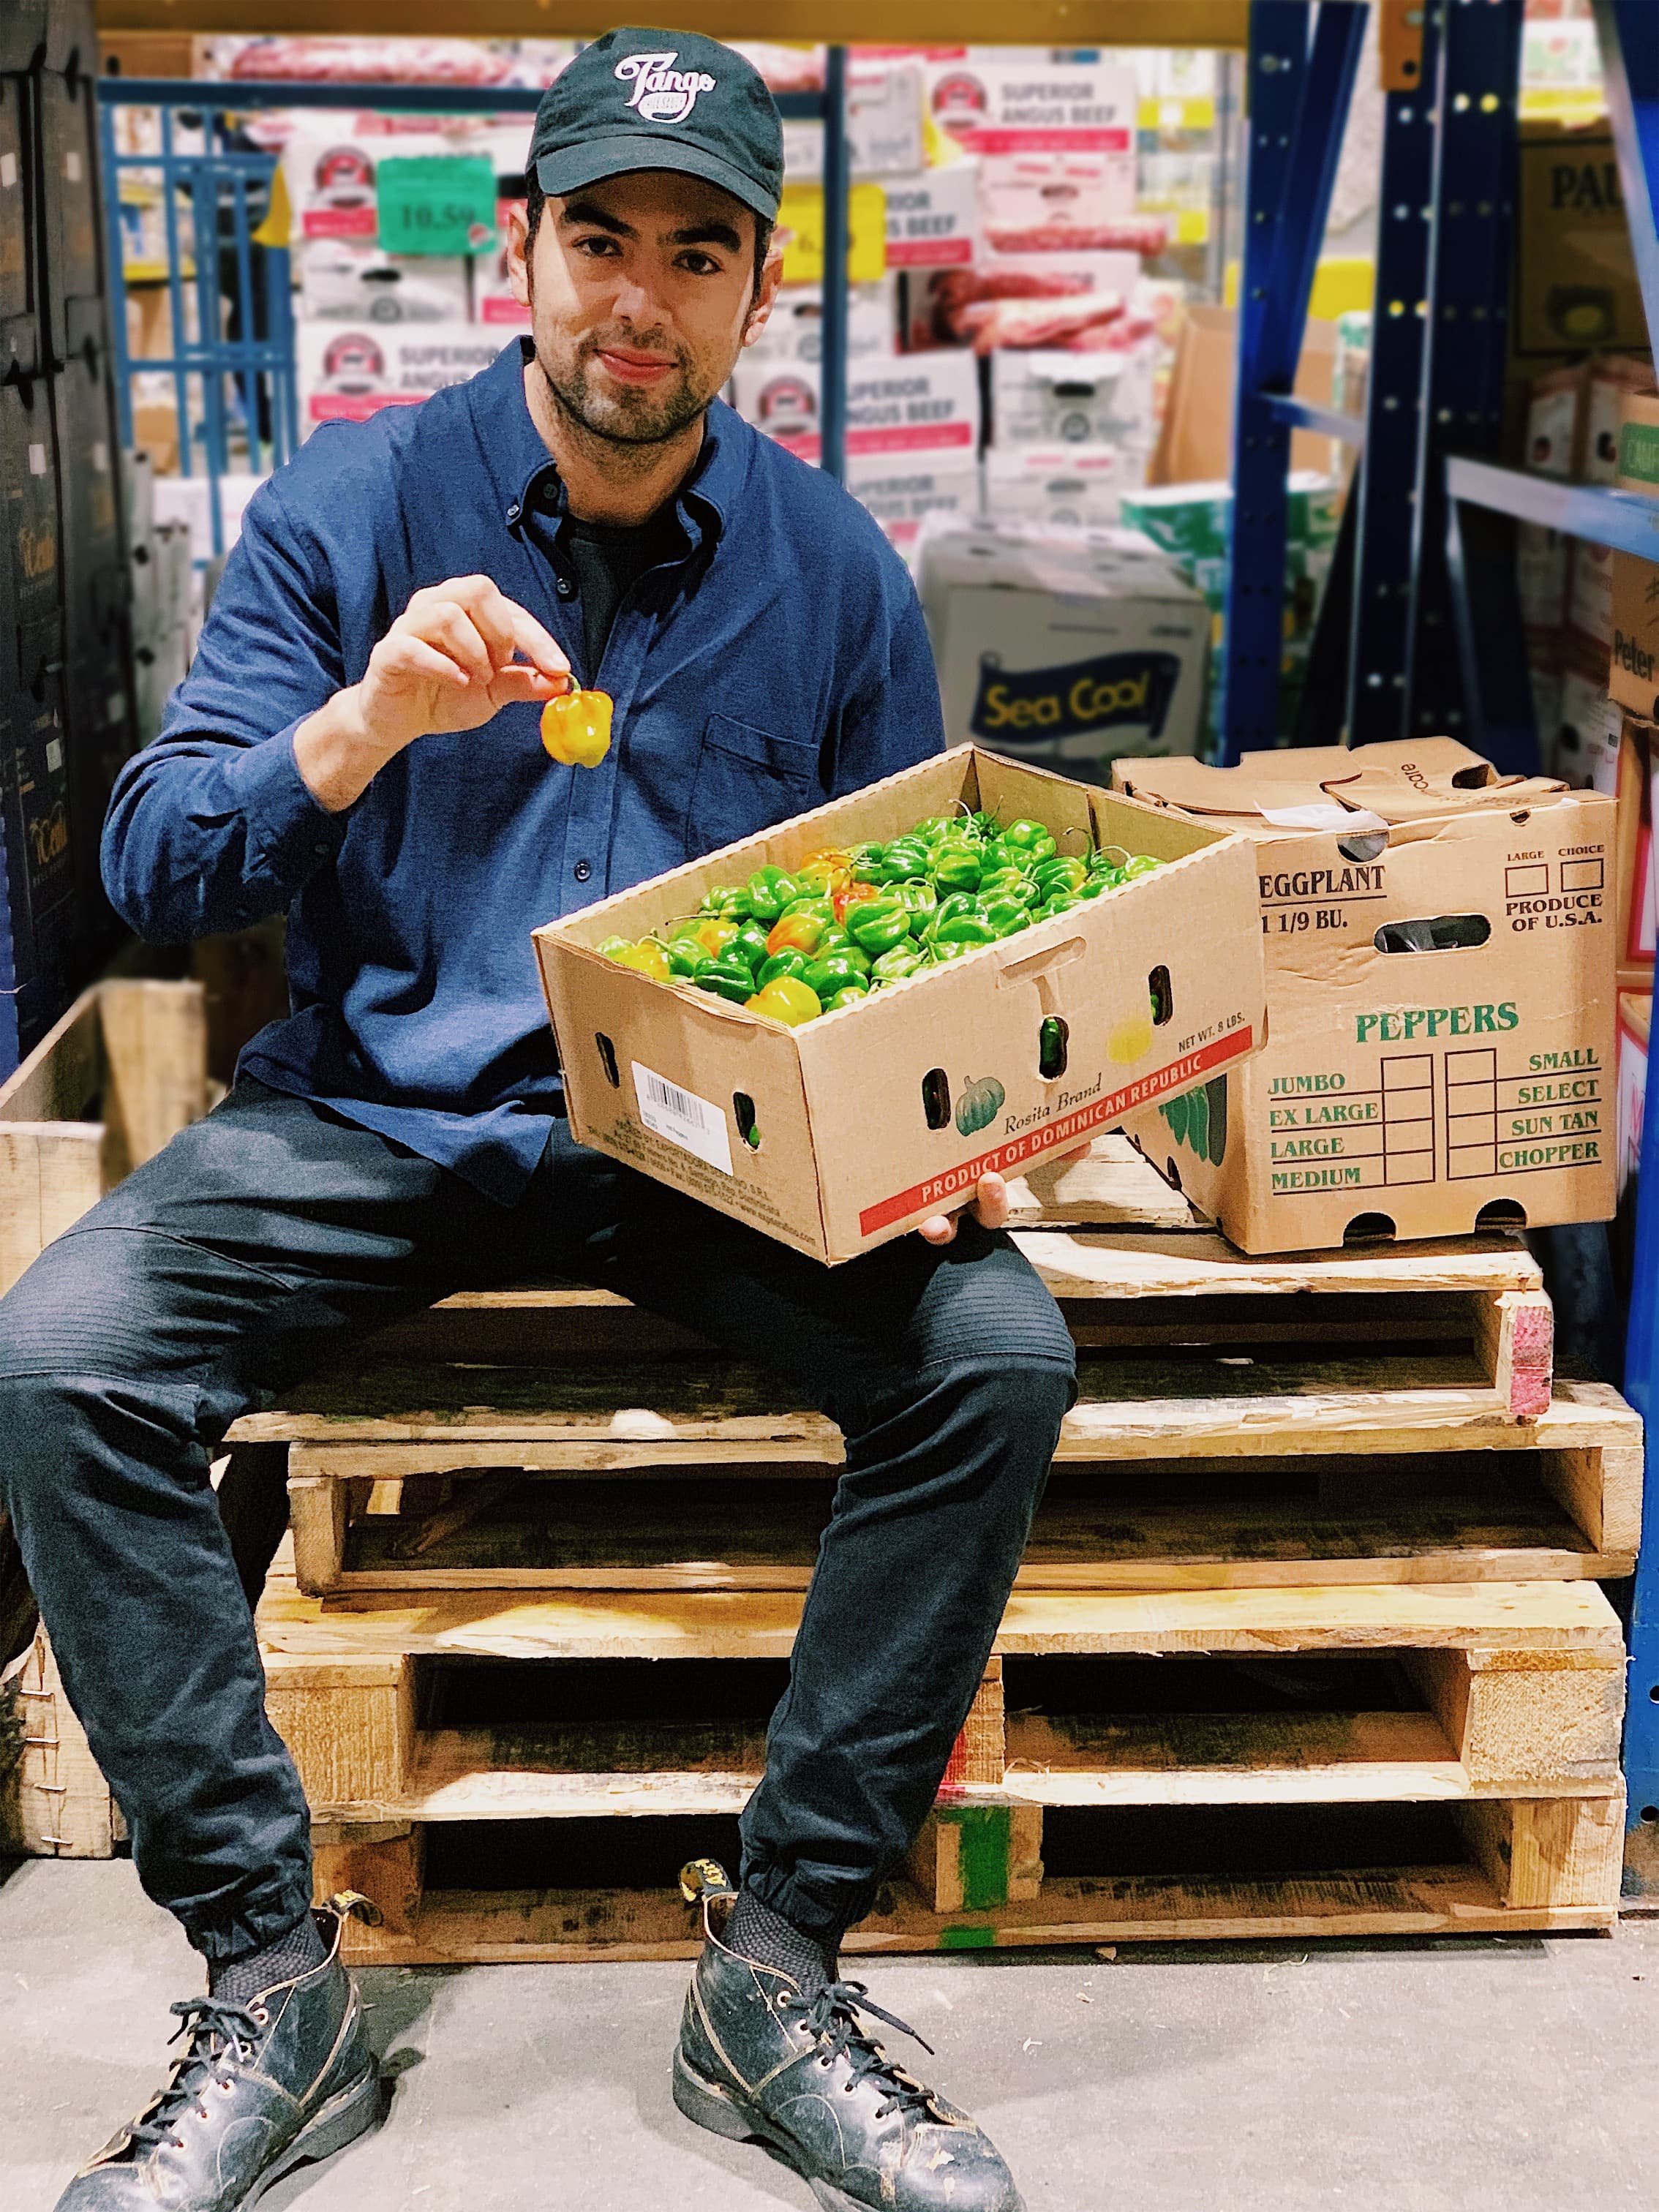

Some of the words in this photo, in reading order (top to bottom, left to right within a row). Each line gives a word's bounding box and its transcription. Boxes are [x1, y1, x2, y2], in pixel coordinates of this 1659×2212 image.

[614, 52, 717, 124] Tango
[1001, 83, 1094, 100] SUPERIOR
[1002, 108, 1064, 123] ANGUS
[1072, 106, 1116, 122] BEEF
[907, 214, 955, 236] BEEF
[399, 346, 499, 364] SUPERIOR
[849, 376, 930, 400] UPERIOR
[846, 405, 902, 425] NGUS
[907, 400, 955, 421] BEEF
[1614, 629, 1655, 682] Peter
[985, 684, 1061, 727] Sea
[1069, 669, 1151, 720] Cool
[1508, 851, 1545, 862] LARGE
[1558, 844, 1605, 857] CHOICE
[1259, 865, 1386, 898] EGGPLANT
[1506, 894, 1603, 916] PRODUCE
[1262, 915, 1271, 933] 1
[1278, 911, 1309, 933] 1/9
[1316, 909, 1348, 929] BU.
[1512, 917, 1538, 932] OF
[1546, 911, 1603, 929] U.S.A.
[1178, 1037, 1195, 1053] NET
[1197, 1026, 1215, 1043] WT.
[1218, 1021, 1224, 1032] 8
[1227, 1012, 1245, 1028] LBS.
[1355, 1001, 1519, 1043] PEPPERS
[1529, 1048, 1599, 1071] SMALL
[1267, 1073, 1345, 1095] JUMBO
[1519, 1080, 1599, 1104] SELECT
[1004, 1107, 1050, 1135] Rosita
[1056, 1072, 1102, 1113] Brand
[1269, 1109, 1298, 1126] EX
[1305, 1102, 1379, 1124] LARGE
[921, 1153, 1000, 1203] PRODUCT
[1005, 1143, 1026, 1162] OF
[1031, 1091, 1126, 1149] DOMINICAN
[1130, 1054, 1202, 1103] REPUBLIC
[1512, 1116, 1552, 1135] SUN
[1559, 1110, 1598, 1130] TAN
[1271, 1137, 1345, 1159] LARGE
[1499, 1142, 1599, 1168] CHOPPER
[1271, 1167, 1361, 1189] MEDIUM
